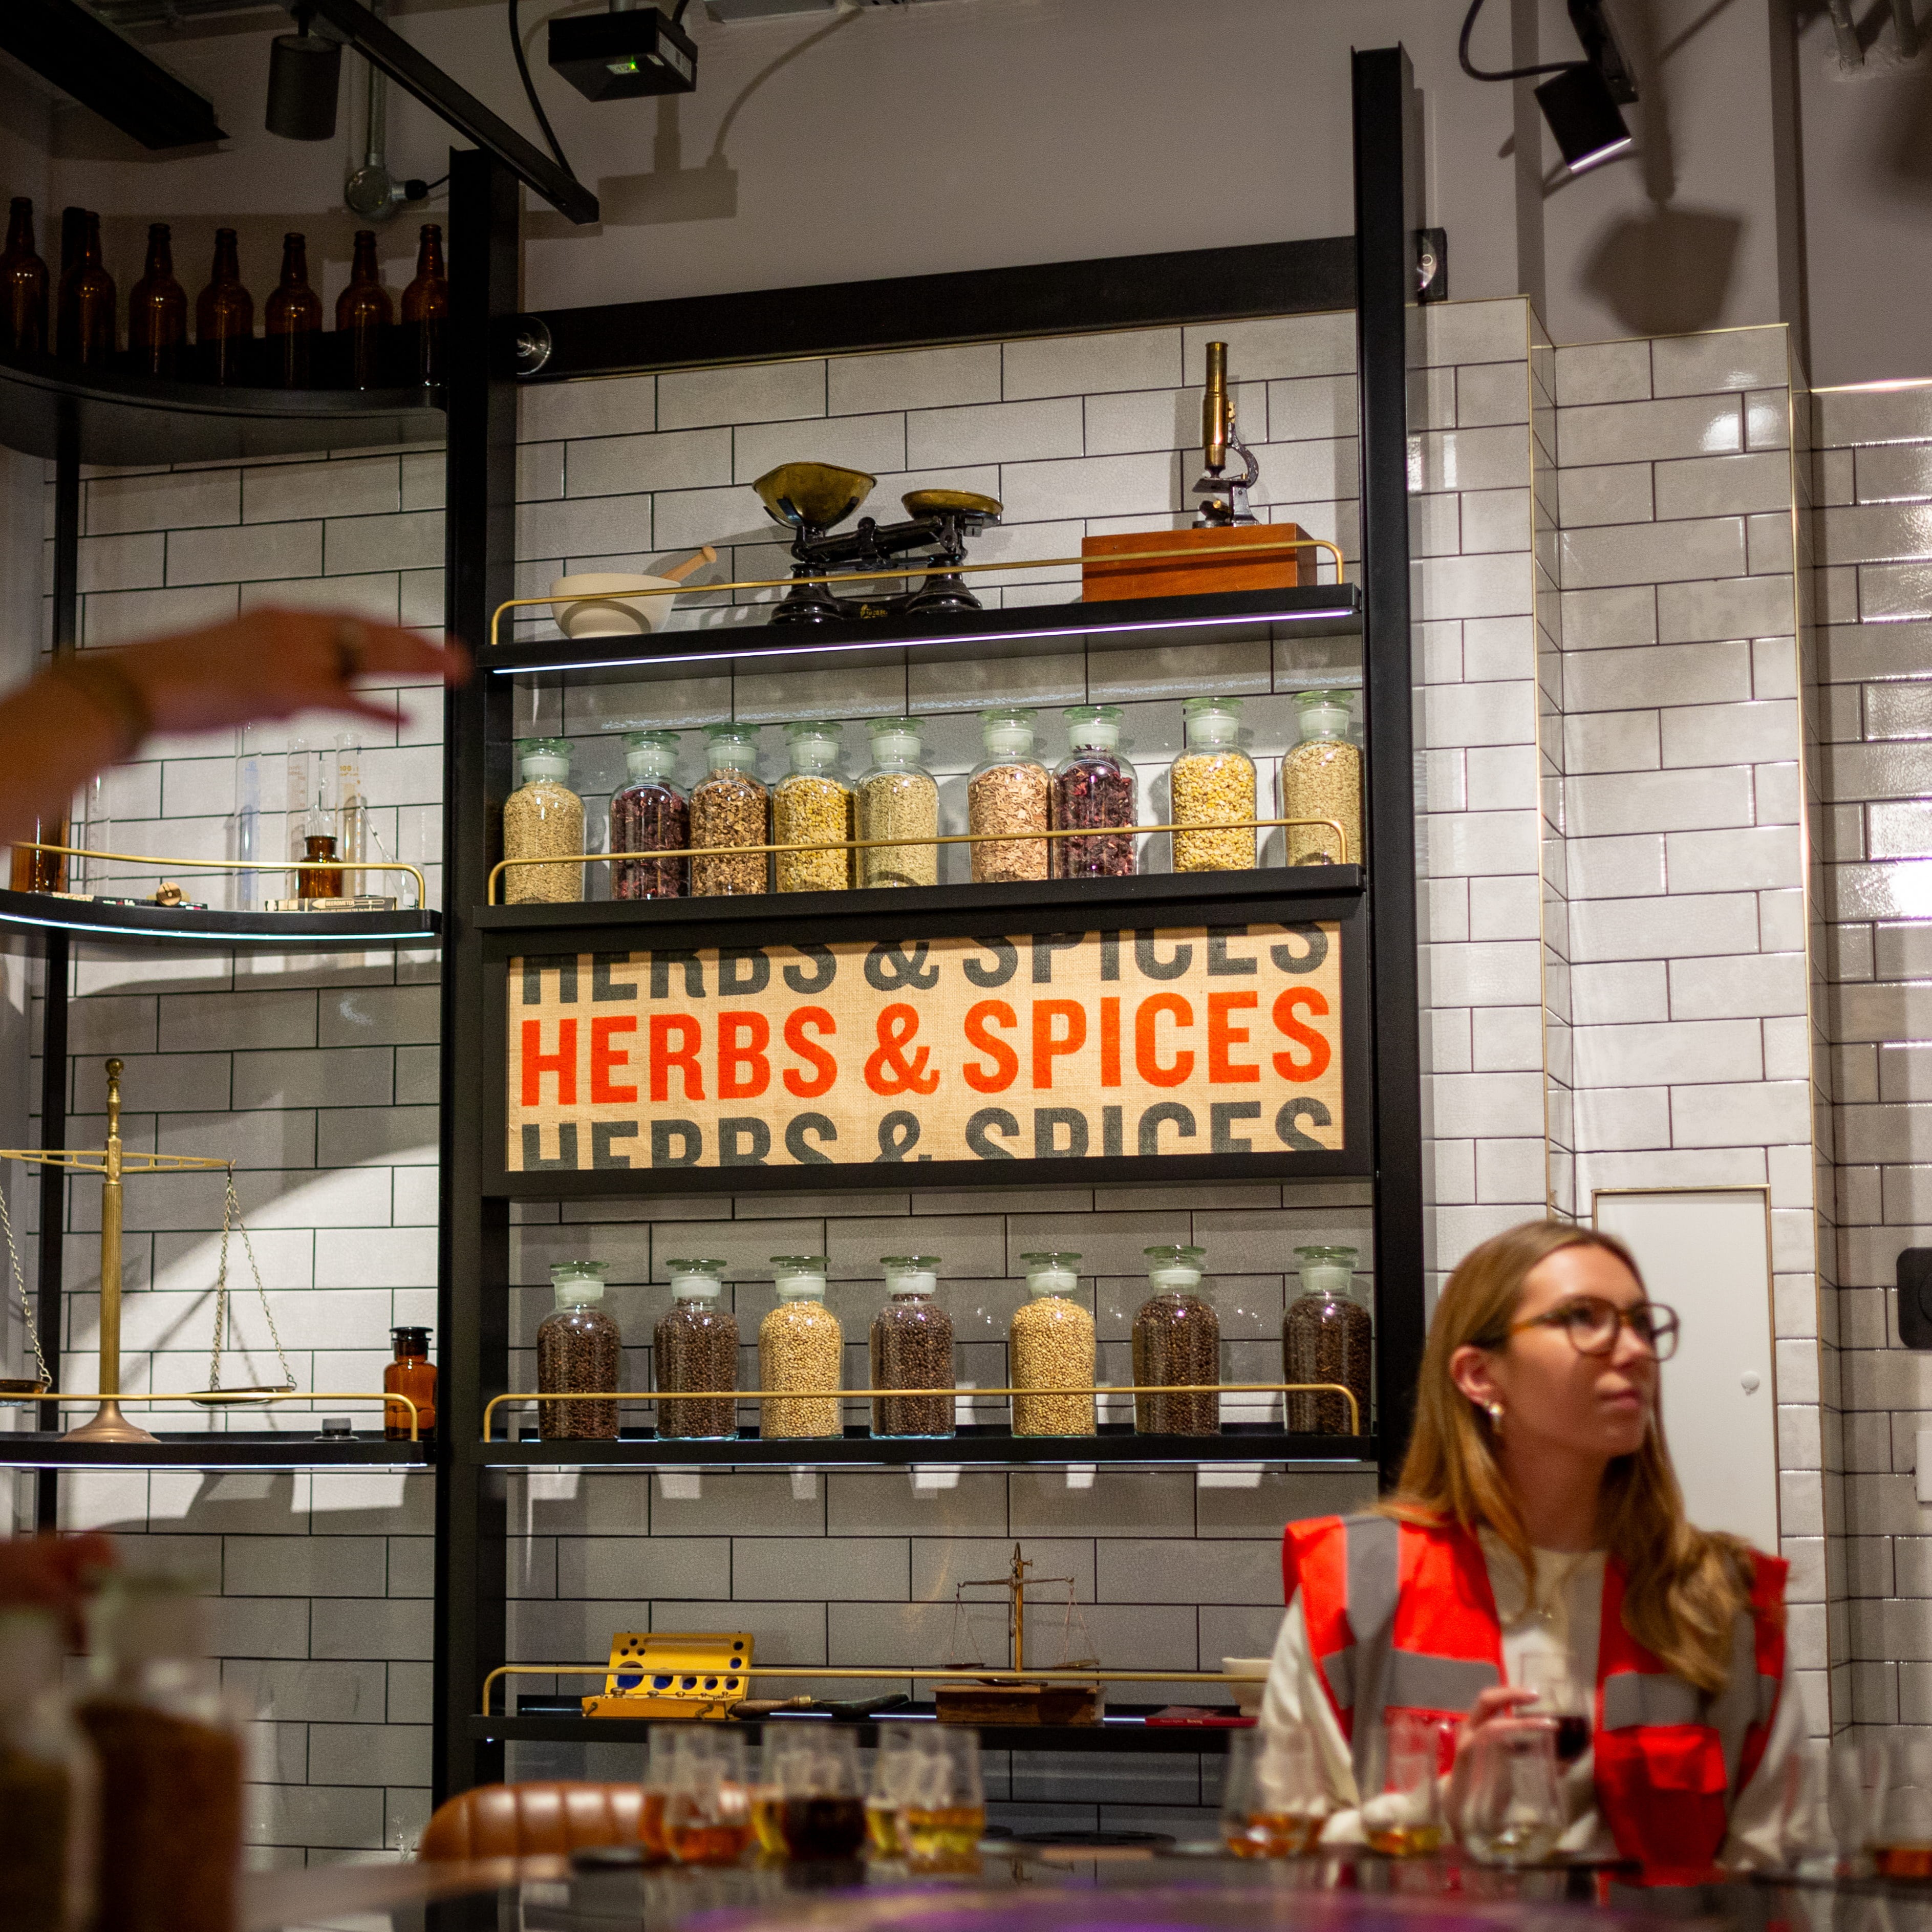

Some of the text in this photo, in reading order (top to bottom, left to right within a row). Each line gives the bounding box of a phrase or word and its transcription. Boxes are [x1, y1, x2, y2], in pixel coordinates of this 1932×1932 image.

[522, 987, 1330, 1106] HERBS & SPICES
